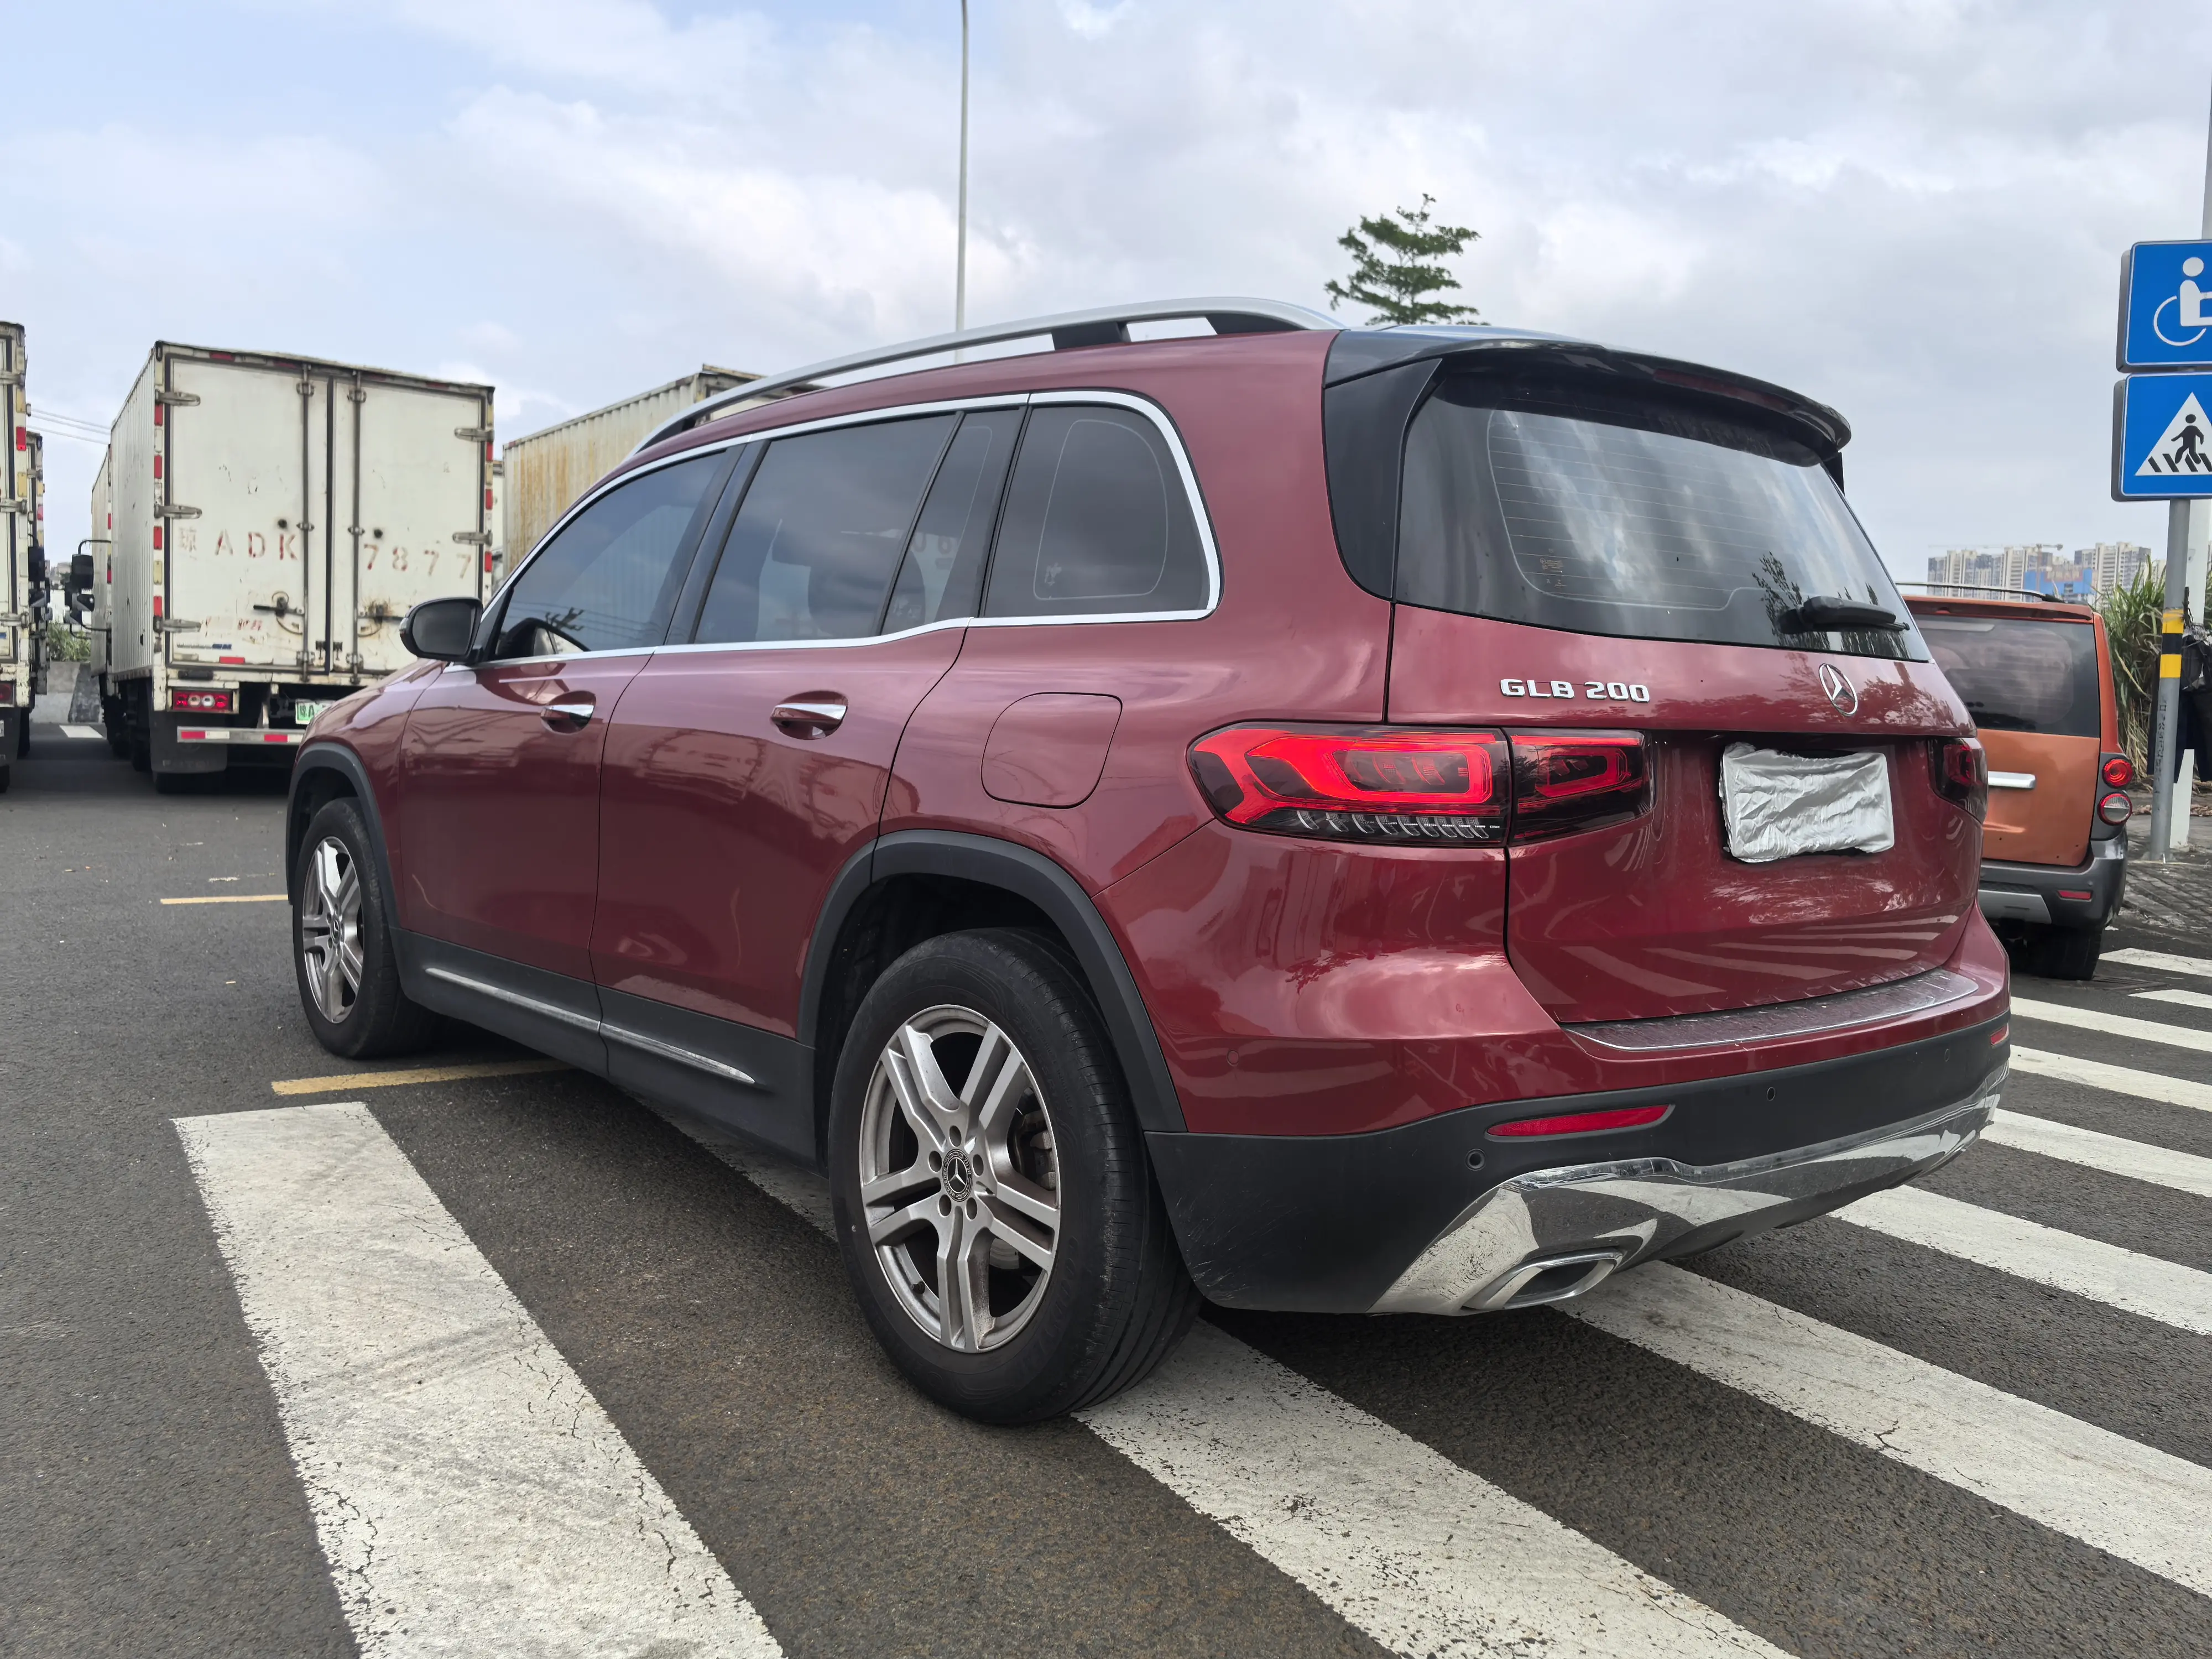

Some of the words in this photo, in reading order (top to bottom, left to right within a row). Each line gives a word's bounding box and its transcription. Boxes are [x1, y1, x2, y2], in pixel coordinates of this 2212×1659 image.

[363, 544, 471, 580] 7877
[1500, 679, 1575, 699] GLB
[1584, 681, 1651, 703] 200
[963, 1158, 972, 1175] BENZ
